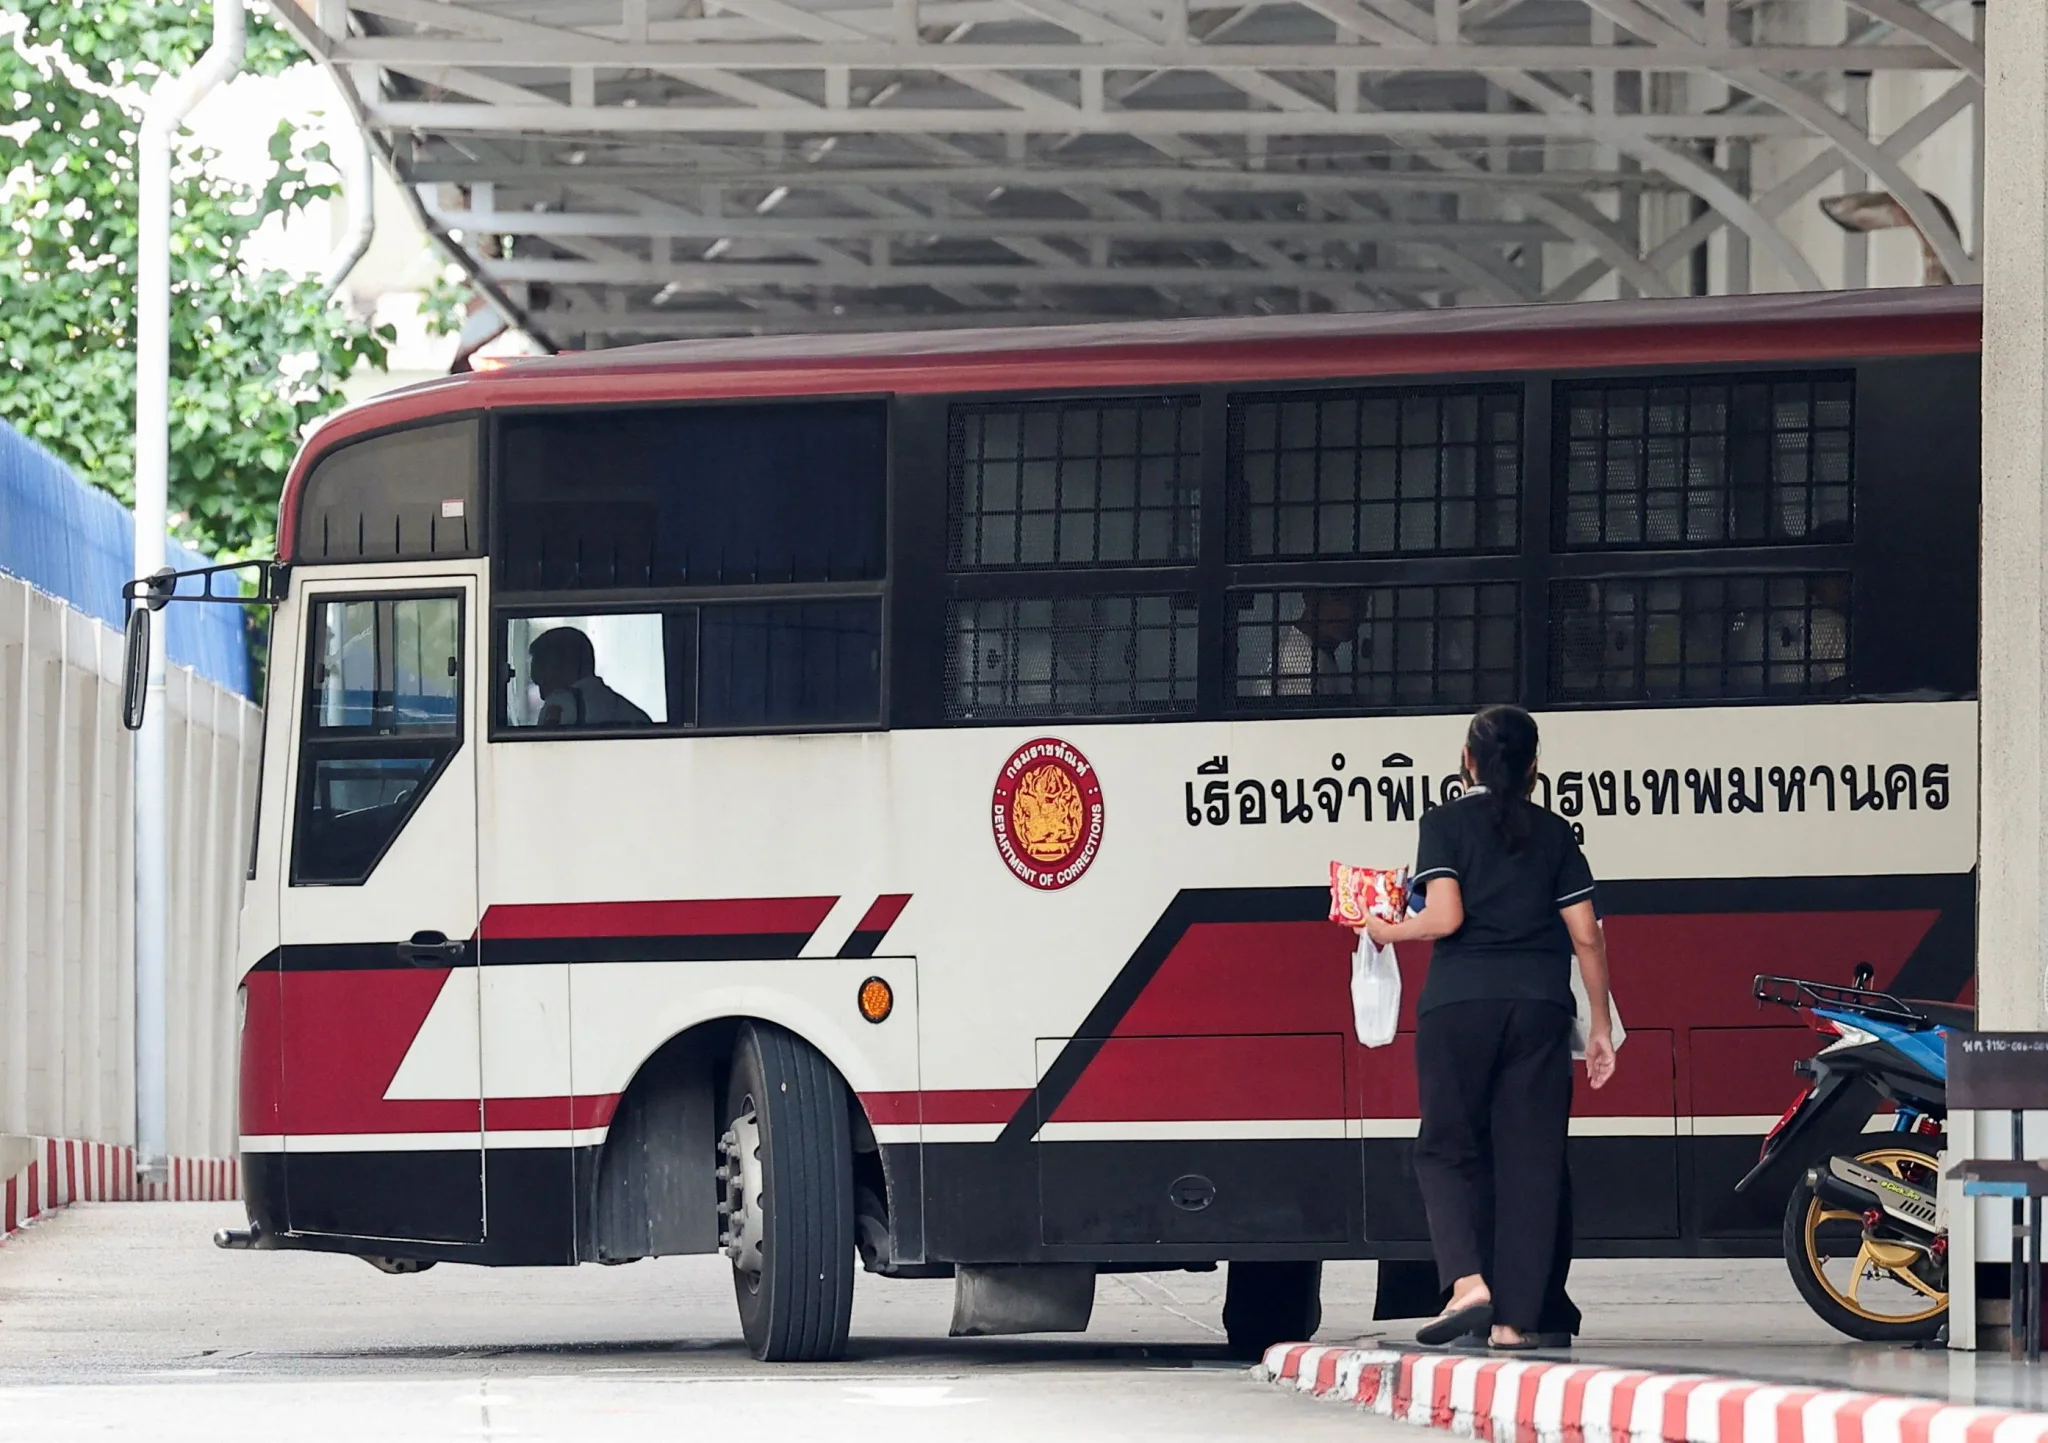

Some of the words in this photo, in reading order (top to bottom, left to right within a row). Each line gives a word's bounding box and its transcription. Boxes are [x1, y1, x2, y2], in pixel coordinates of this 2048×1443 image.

[1006, 742, 1090, 779] กรมราชทัณฑ์
[994, 804, 1037, 882] DEPARTMENT
[1039, 873, 1053, 886] OF
[1057, 803, 1102, 884] CORRECTIONS
